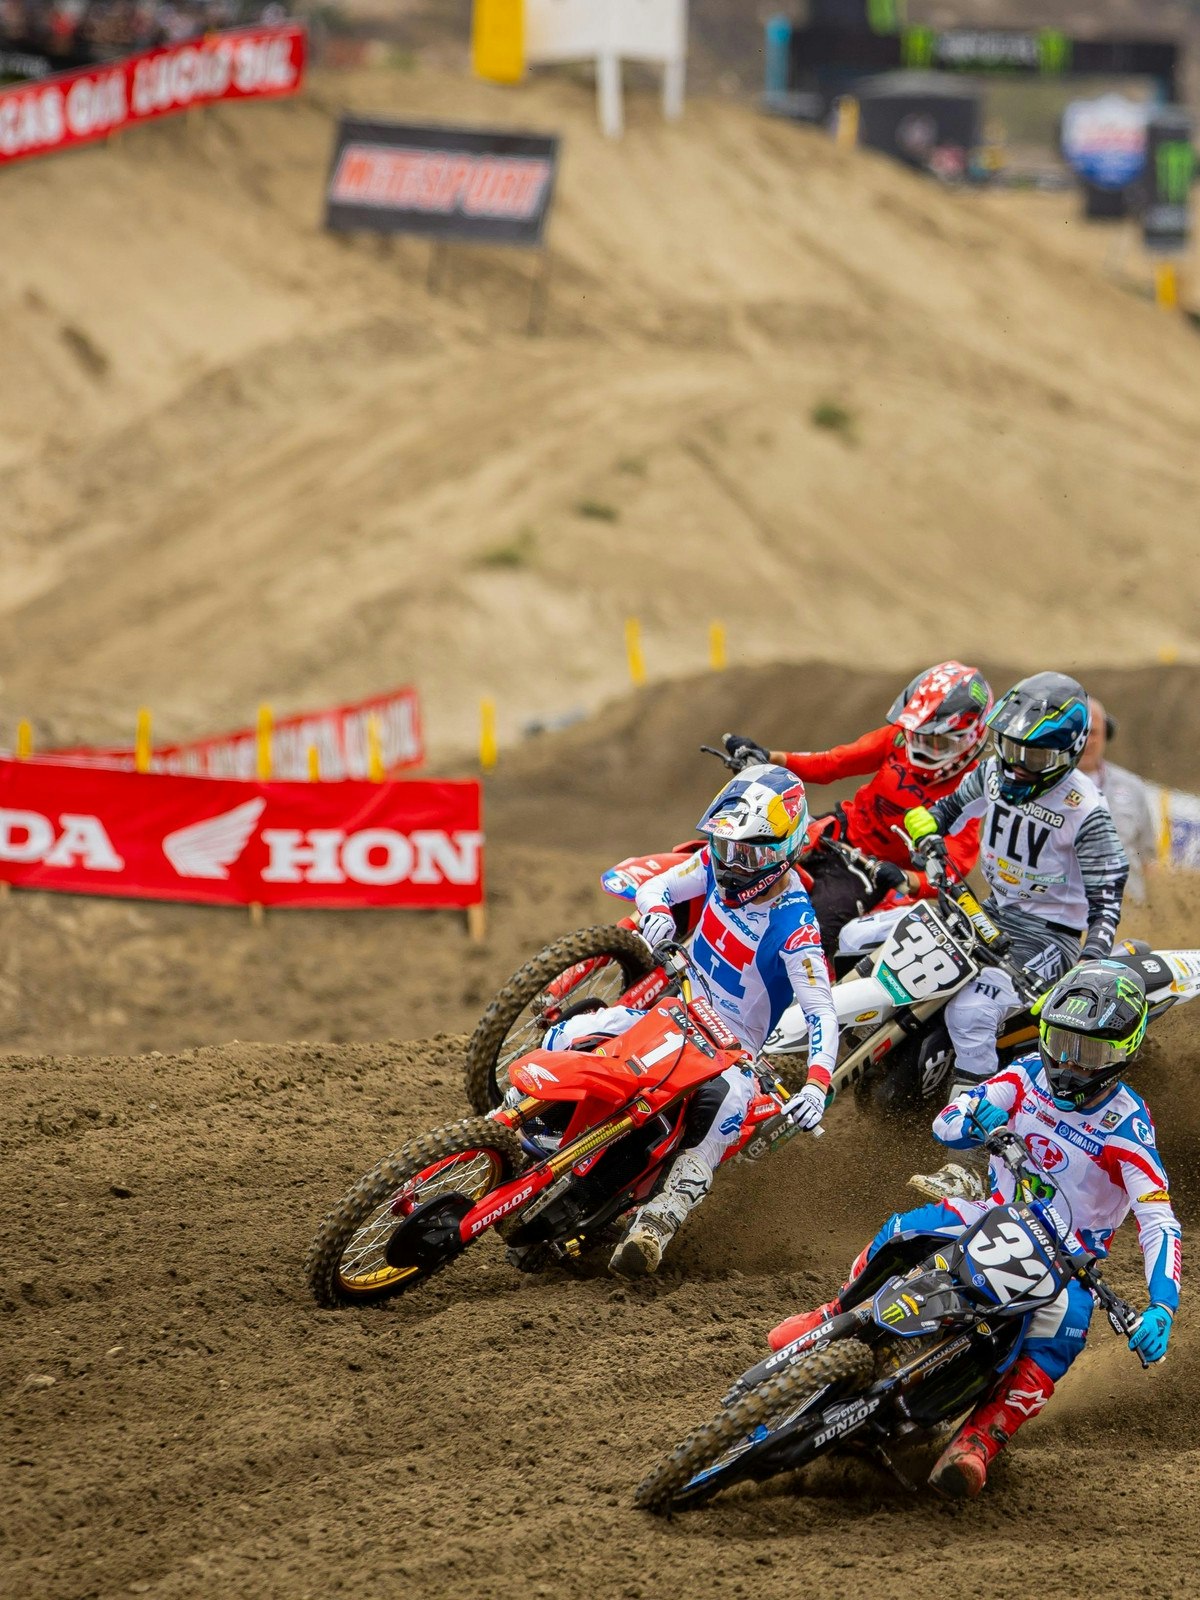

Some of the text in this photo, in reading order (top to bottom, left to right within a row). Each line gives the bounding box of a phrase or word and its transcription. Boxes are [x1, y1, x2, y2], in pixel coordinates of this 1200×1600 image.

[1018, 801, 1064, 829] qvarna
[988, 802, 1052, 869] FLY
[261, 828, 484, 886] HON
[738, 878, 767, 904] Red
[883, 921, 960, 999] 38
[943, 942, 956, 957] OIL
[632, 980, 664, 1010] LOP
[974, 982, 1001, 1001] FLY
[692, 1002, 729, 1045] RENTHAL
[640, 1031, 688, 1068] 1
[695, 1035, 707, 1048] OIL
[1068, 1128, 1100, 1156] YAMAHA
[470, 1185, 534, 1235] DUNLOP
[1025, 1219, 1056, 1261] LUCAS OIL
[966, 1221, 1056, 1305] 32
[1065, 1326, 1083, 1339] THOR
[813, 1398, 880, 1449] DUNLOP
[840, 1399, 866, 1418] CYCRA
